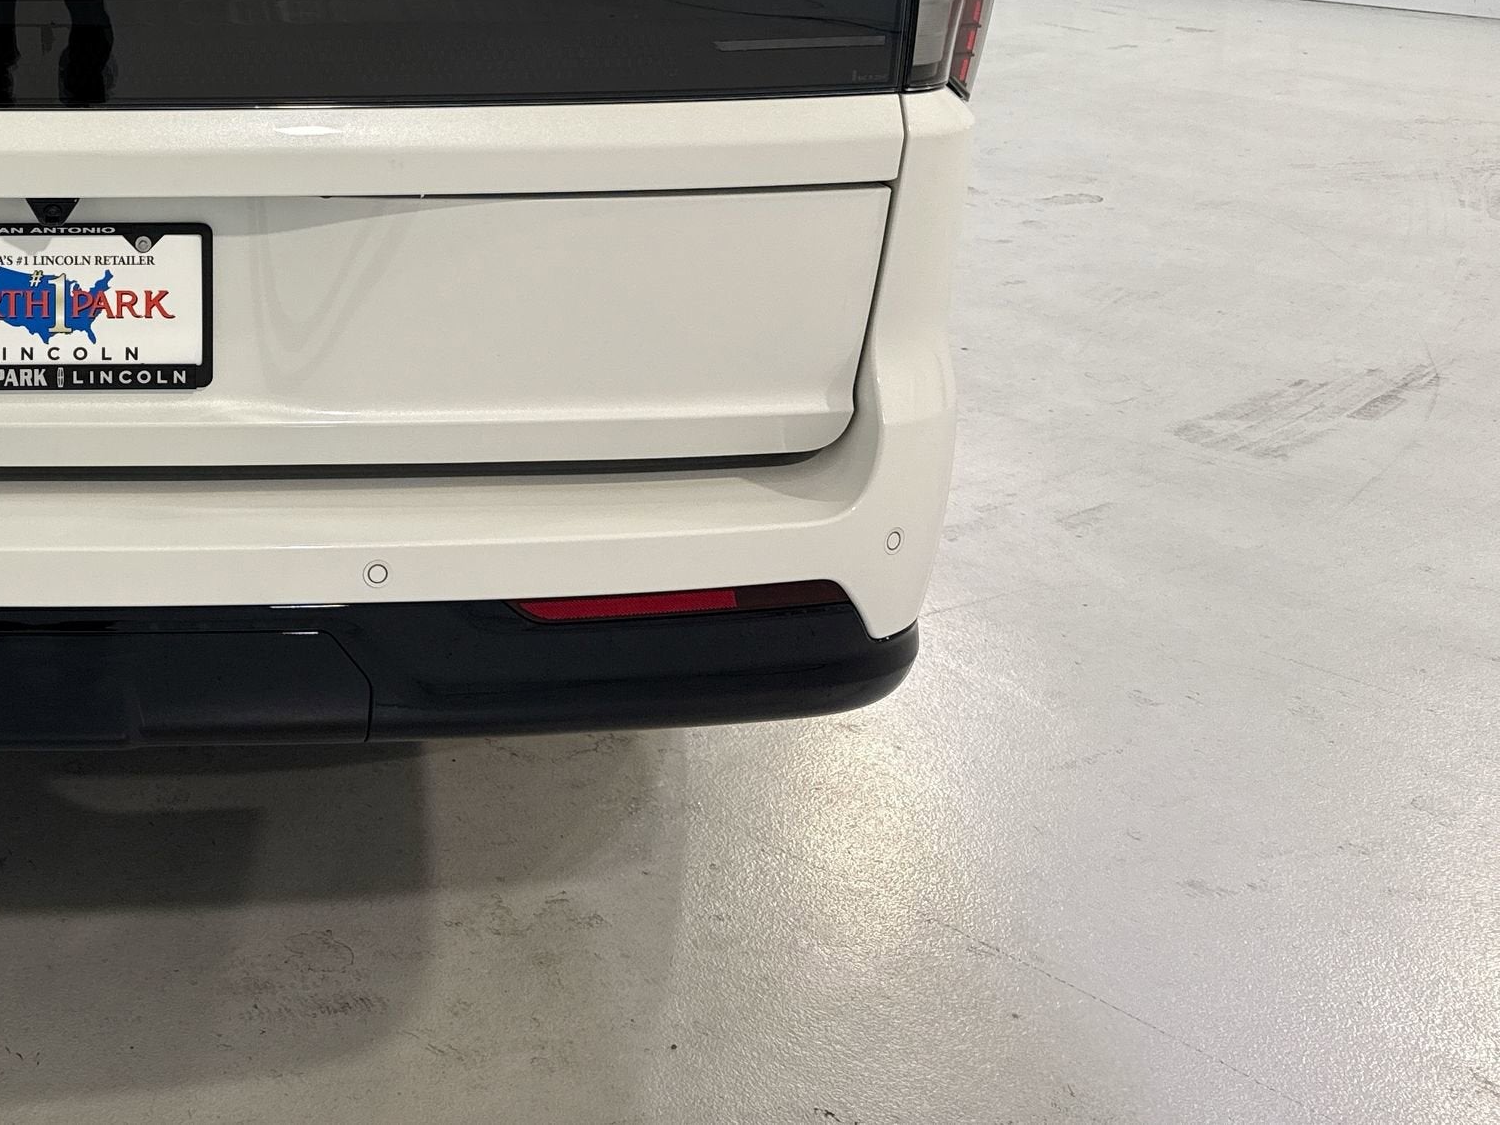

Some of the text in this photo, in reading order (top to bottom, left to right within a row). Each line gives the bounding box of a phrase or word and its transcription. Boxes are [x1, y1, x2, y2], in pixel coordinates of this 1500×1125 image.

[29, 226, 116, 235] ANTONIO
[16, 255, 29, 266] #1
[32, 255, 91, 266] LINCOLN
[94, 255, 156, 266] RETAILER
[71, 289, 176, 320] PARK
[72, 369, 187, 385] LINCOLN
